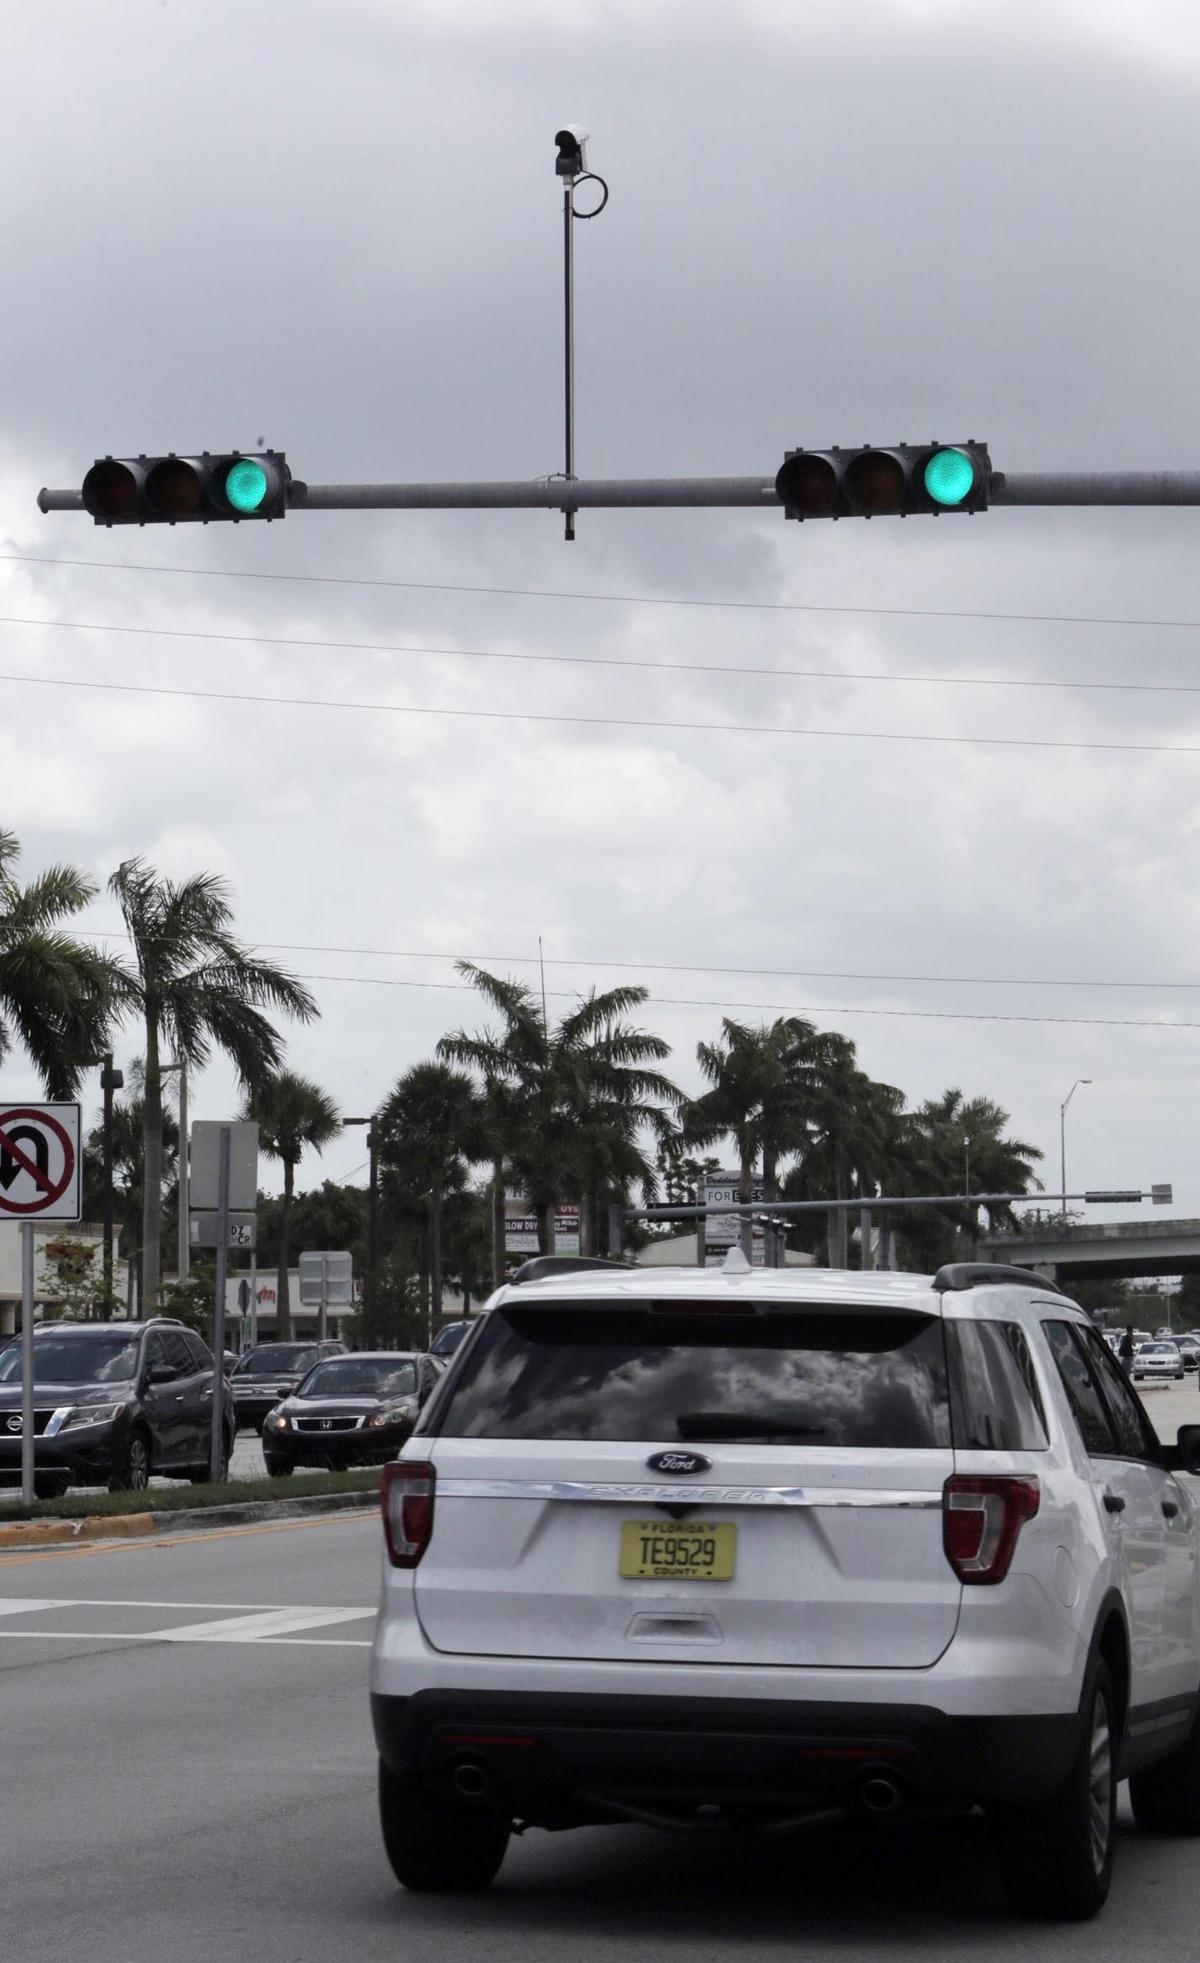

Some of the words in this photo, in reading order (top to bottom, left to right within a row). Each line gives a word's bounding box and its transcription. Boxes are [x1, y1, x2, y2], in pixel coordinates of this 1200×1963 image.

[708, 1191, 731, 1201] FOR
[658, 1453, 697, 1471] Ford
[651, 1524, 705, 1533] FLORIDA
[639, 1537, 716, 1566] TE9529
[653, 1567, 698, 1576] COUNTY
